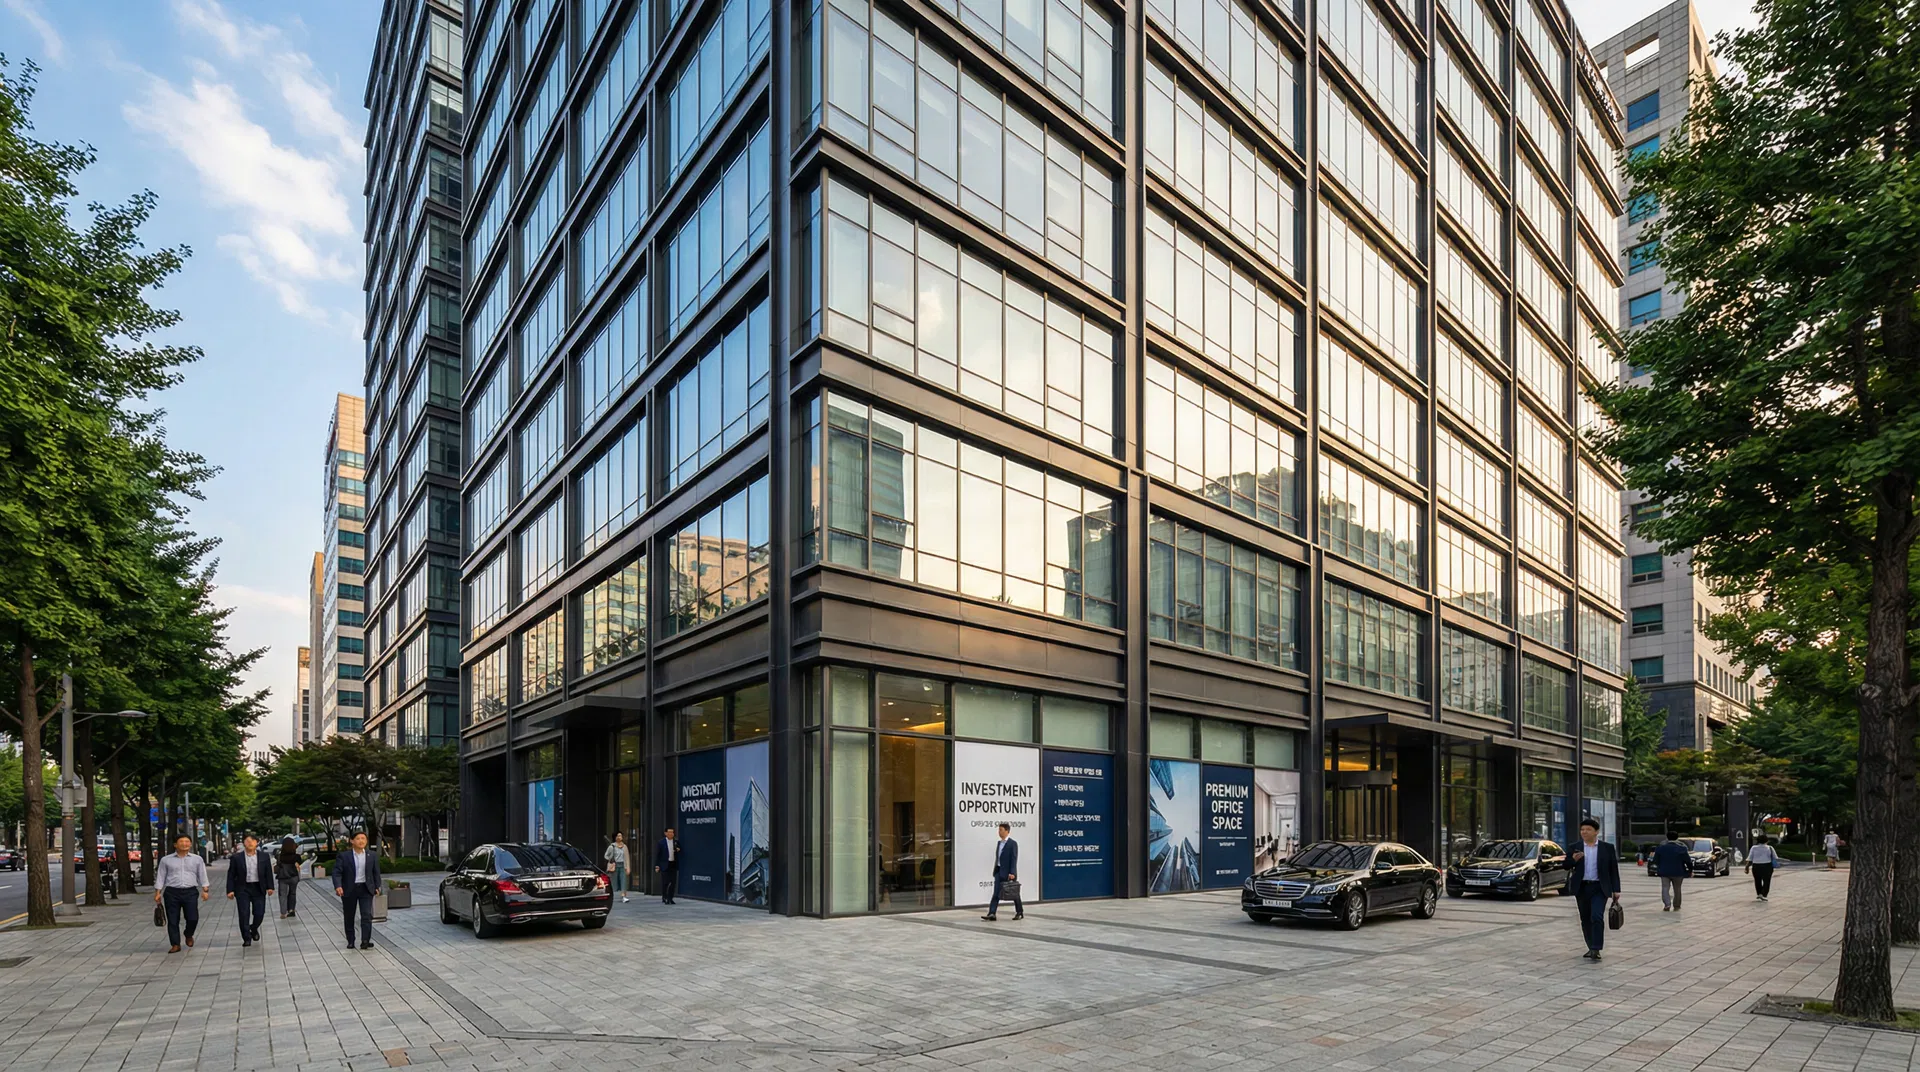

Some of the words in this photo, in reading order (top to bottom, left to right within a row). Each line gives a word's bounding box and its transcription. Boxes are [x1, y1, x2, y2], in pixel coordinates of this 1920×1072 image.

[961, 782, 1034, 797] INVESTMENT
[1205, 783, 1249, 798] PREMIUM
[959, 800, 1036, 814] OPPORTUNITY
[1211, 800, 1244, 814] OFFICE
[1212, 816, 1243, 830] SPACE
